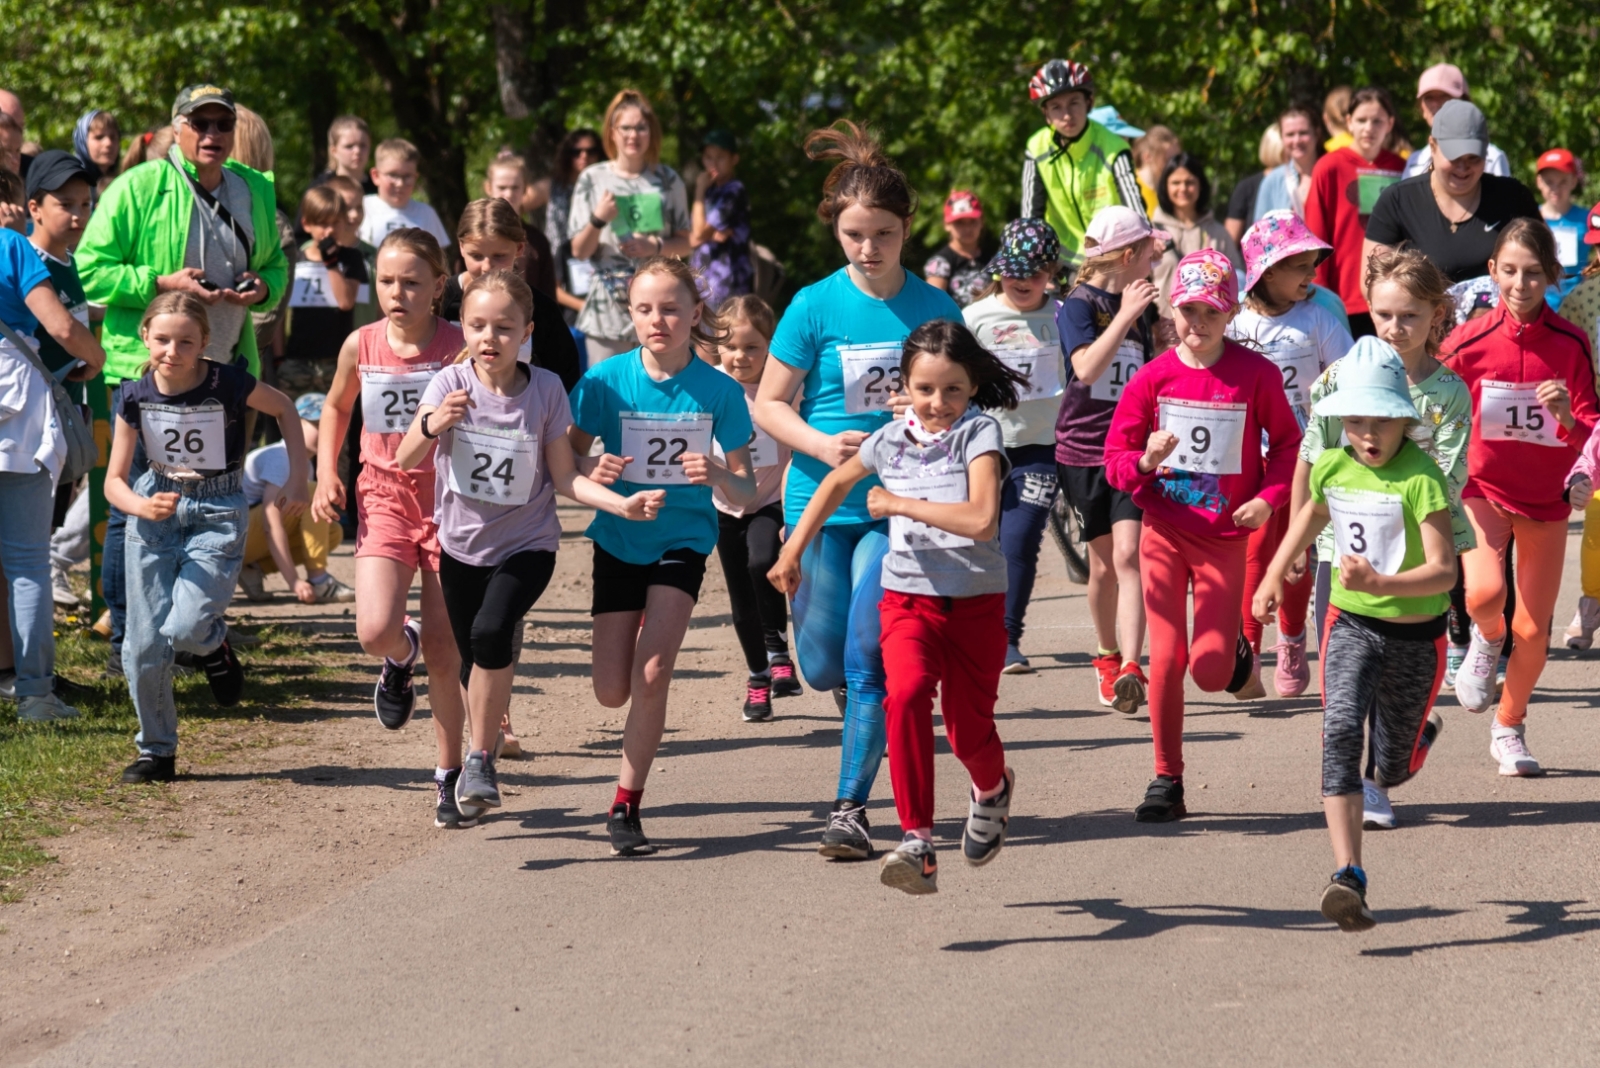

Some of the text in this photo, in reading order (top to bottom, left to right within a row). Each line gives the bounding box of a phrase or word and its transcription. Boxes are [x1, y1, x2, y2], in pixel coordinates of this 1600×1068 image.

[629, 204, 642, 222] 6
[301, 277, 324, 295] 71
[864, 365, 904, 394] 23
[1017, 362, 1033, 380] 7
[381, 389, 420, 416] 25
[1505, 405, 1545, 431] 15
[163, 428, 204, 454] 26
[647, 437, 688, 466] 22
[1190, 425, 1211, 454] 9
[470, 452, 515, 486] 24
[1022, 477, 1057, 505] 92
[1348, 521, 1368, 554] 3
